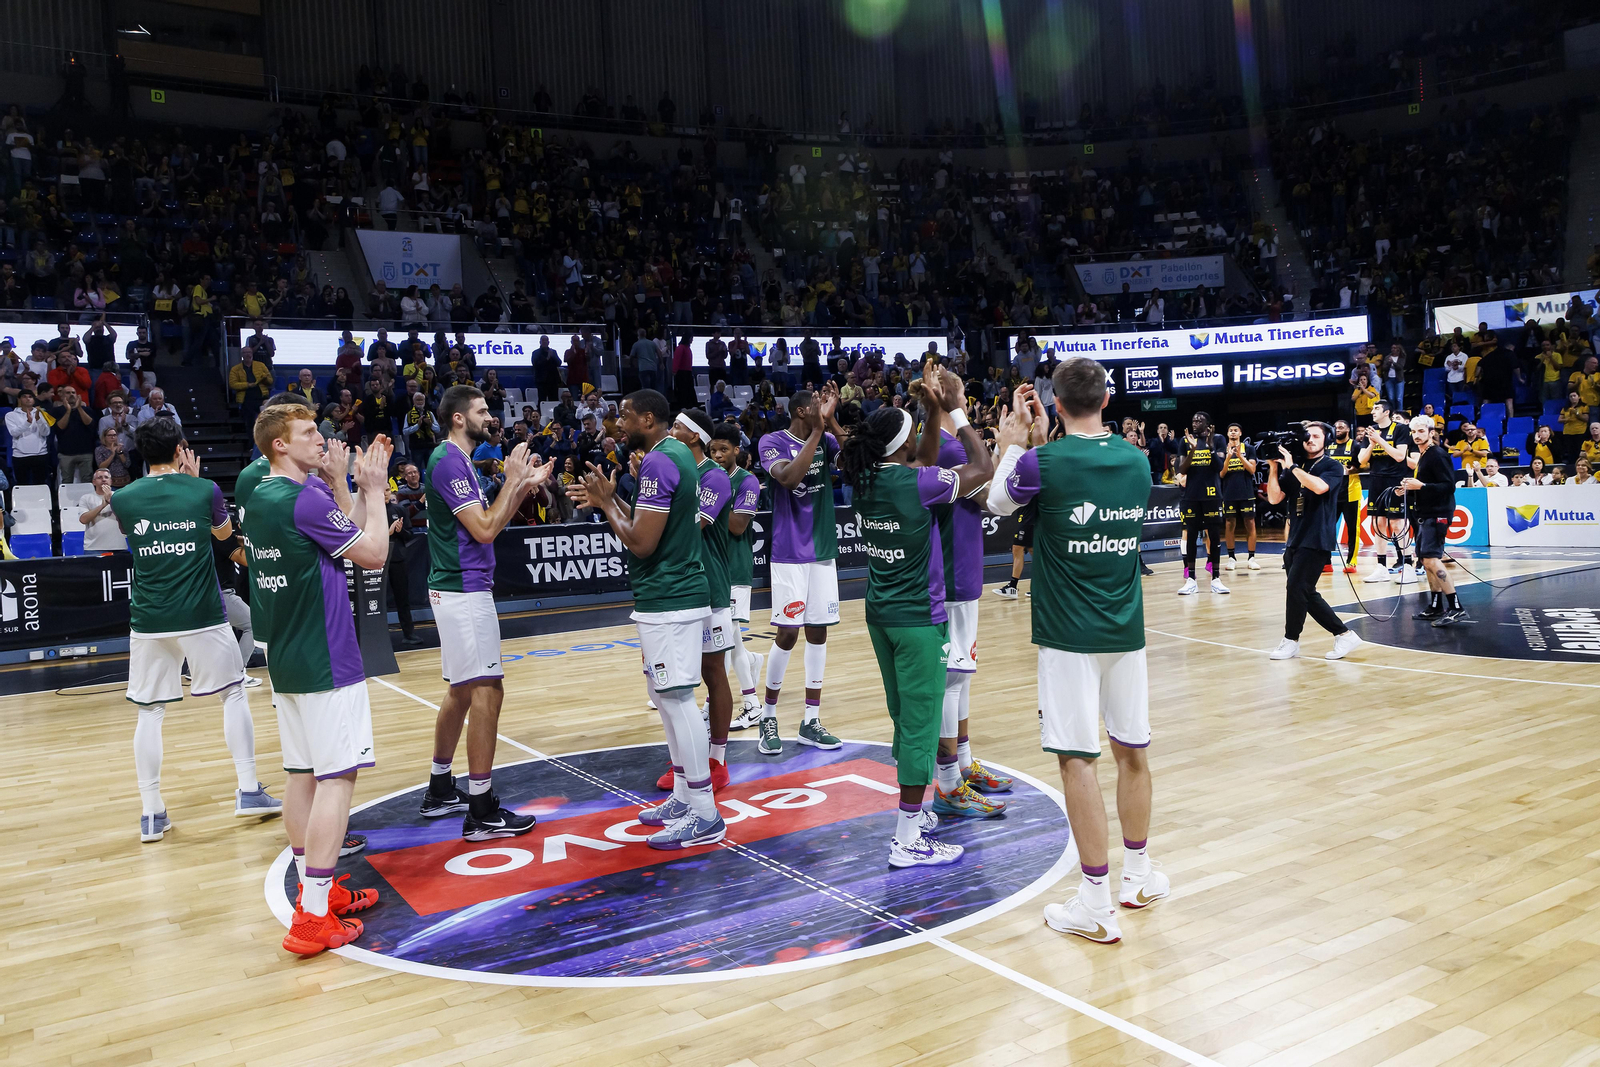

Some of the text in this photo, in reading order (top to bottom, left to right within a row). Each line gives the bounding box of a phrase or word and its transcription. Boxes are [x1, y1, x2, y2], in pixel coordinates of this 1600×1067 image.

[154, 91, 162, 100] D
[1411, 105, 1418, 113] H
[401, 262, 441, 277] DXT
[1119, 265, 1153, 279] DXT
[1160, 262, 1203, 273] Pabellón
[1162, 272, 1220, 284] de deportes
[1214, 324, 1345, 345] Mutua Tinerfeña
[1053, 336, 1170, 353] Mutua Tinerfeña
[1175, 370, 1219, 380] metabo
[1233, 361, 1346, 383] Hisense
[1132, 379, 1160, 389] grupo
[1206, 486, 1217, 496] 12
[1099, 505, 1144, 522] Unicaja
[1543, 508, 1596, 522] Mutua
[153, 519, 197, 533] Unicaja
[862, 519, 901, 534] Unicaja
[523, 532, 629, 560] TERREN
[254, 546, 282, 562] Unicaja
[525, 556, 630, 584] YNAVES:
[4, 626, 19, 634] SUR
